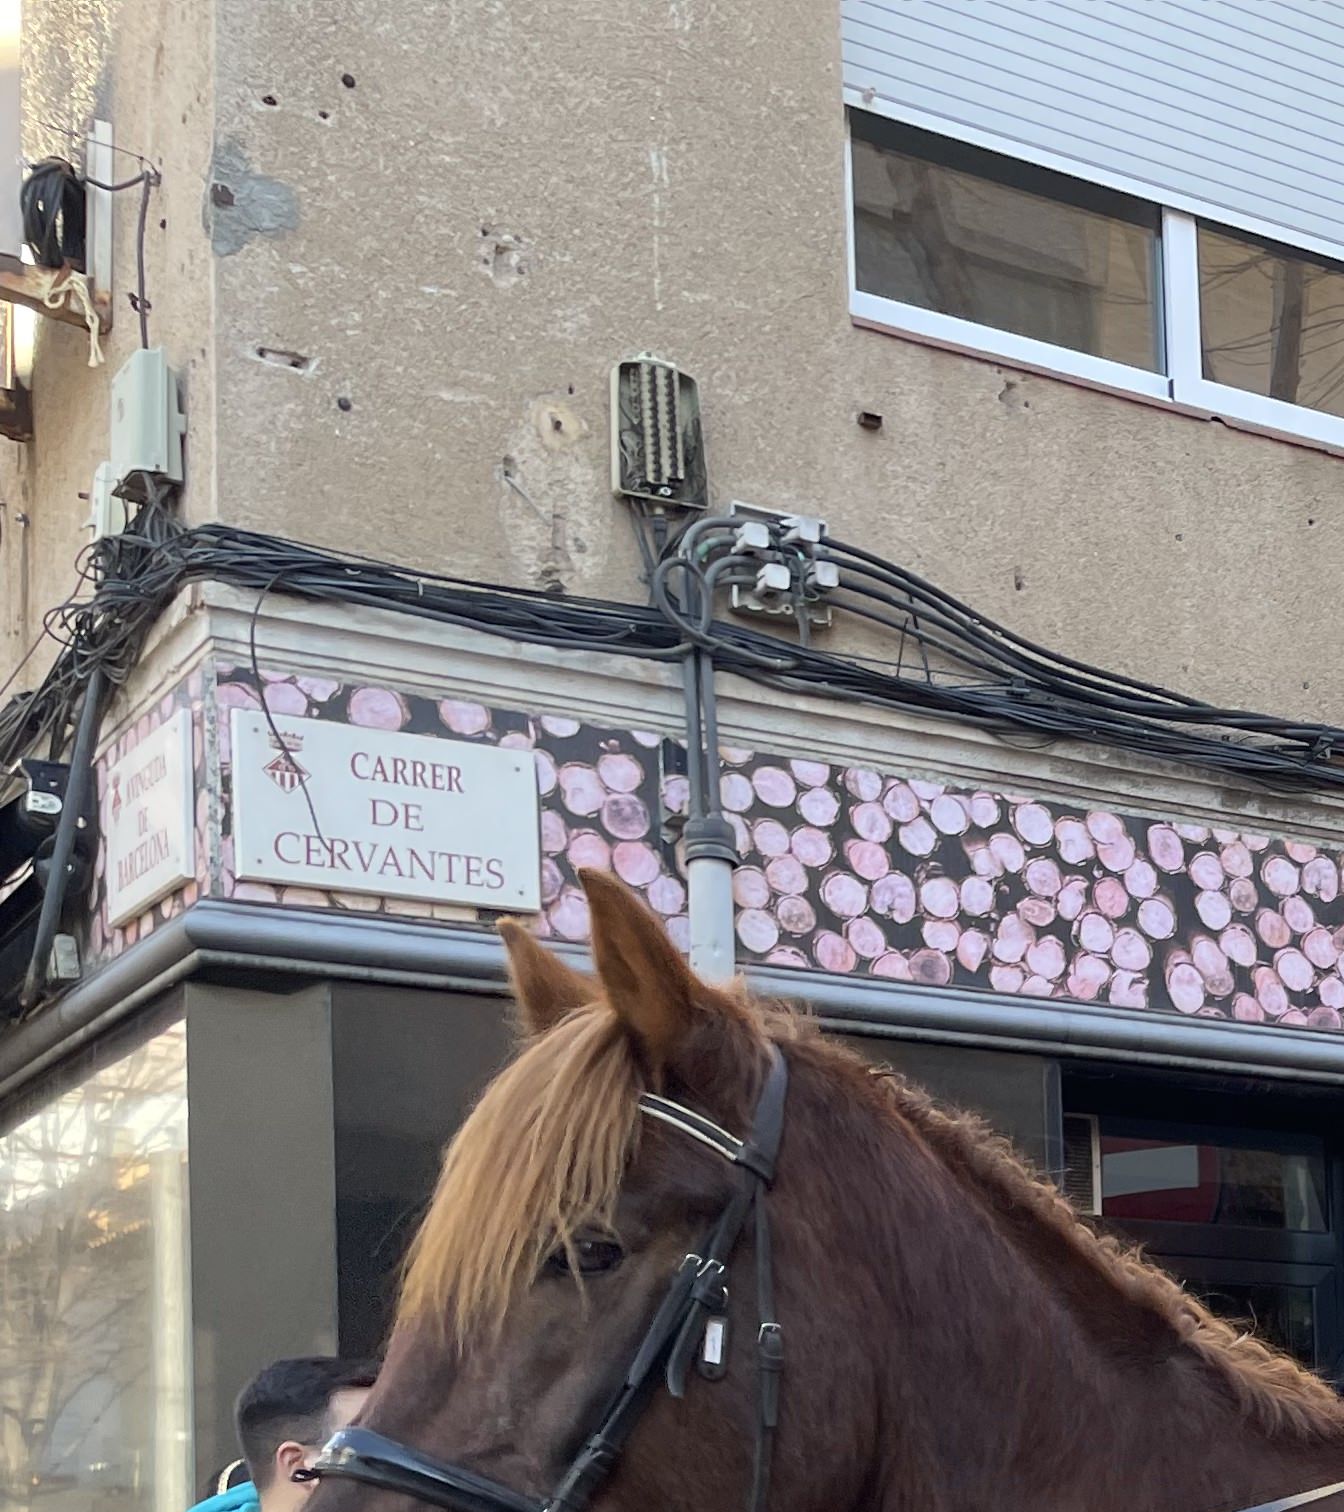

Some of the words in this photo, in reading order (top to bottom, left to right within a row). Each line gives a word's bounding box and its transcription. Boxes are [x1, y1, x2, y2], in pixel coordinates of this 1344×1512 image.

[350, 752, 464, 794] CARRER
[137, 806, 148, 837] DE
[369, 798, 424, 832] DE
[118, 829, 170, 892] BARCELONA
[274, 832, 505, 889] CERVANTES
